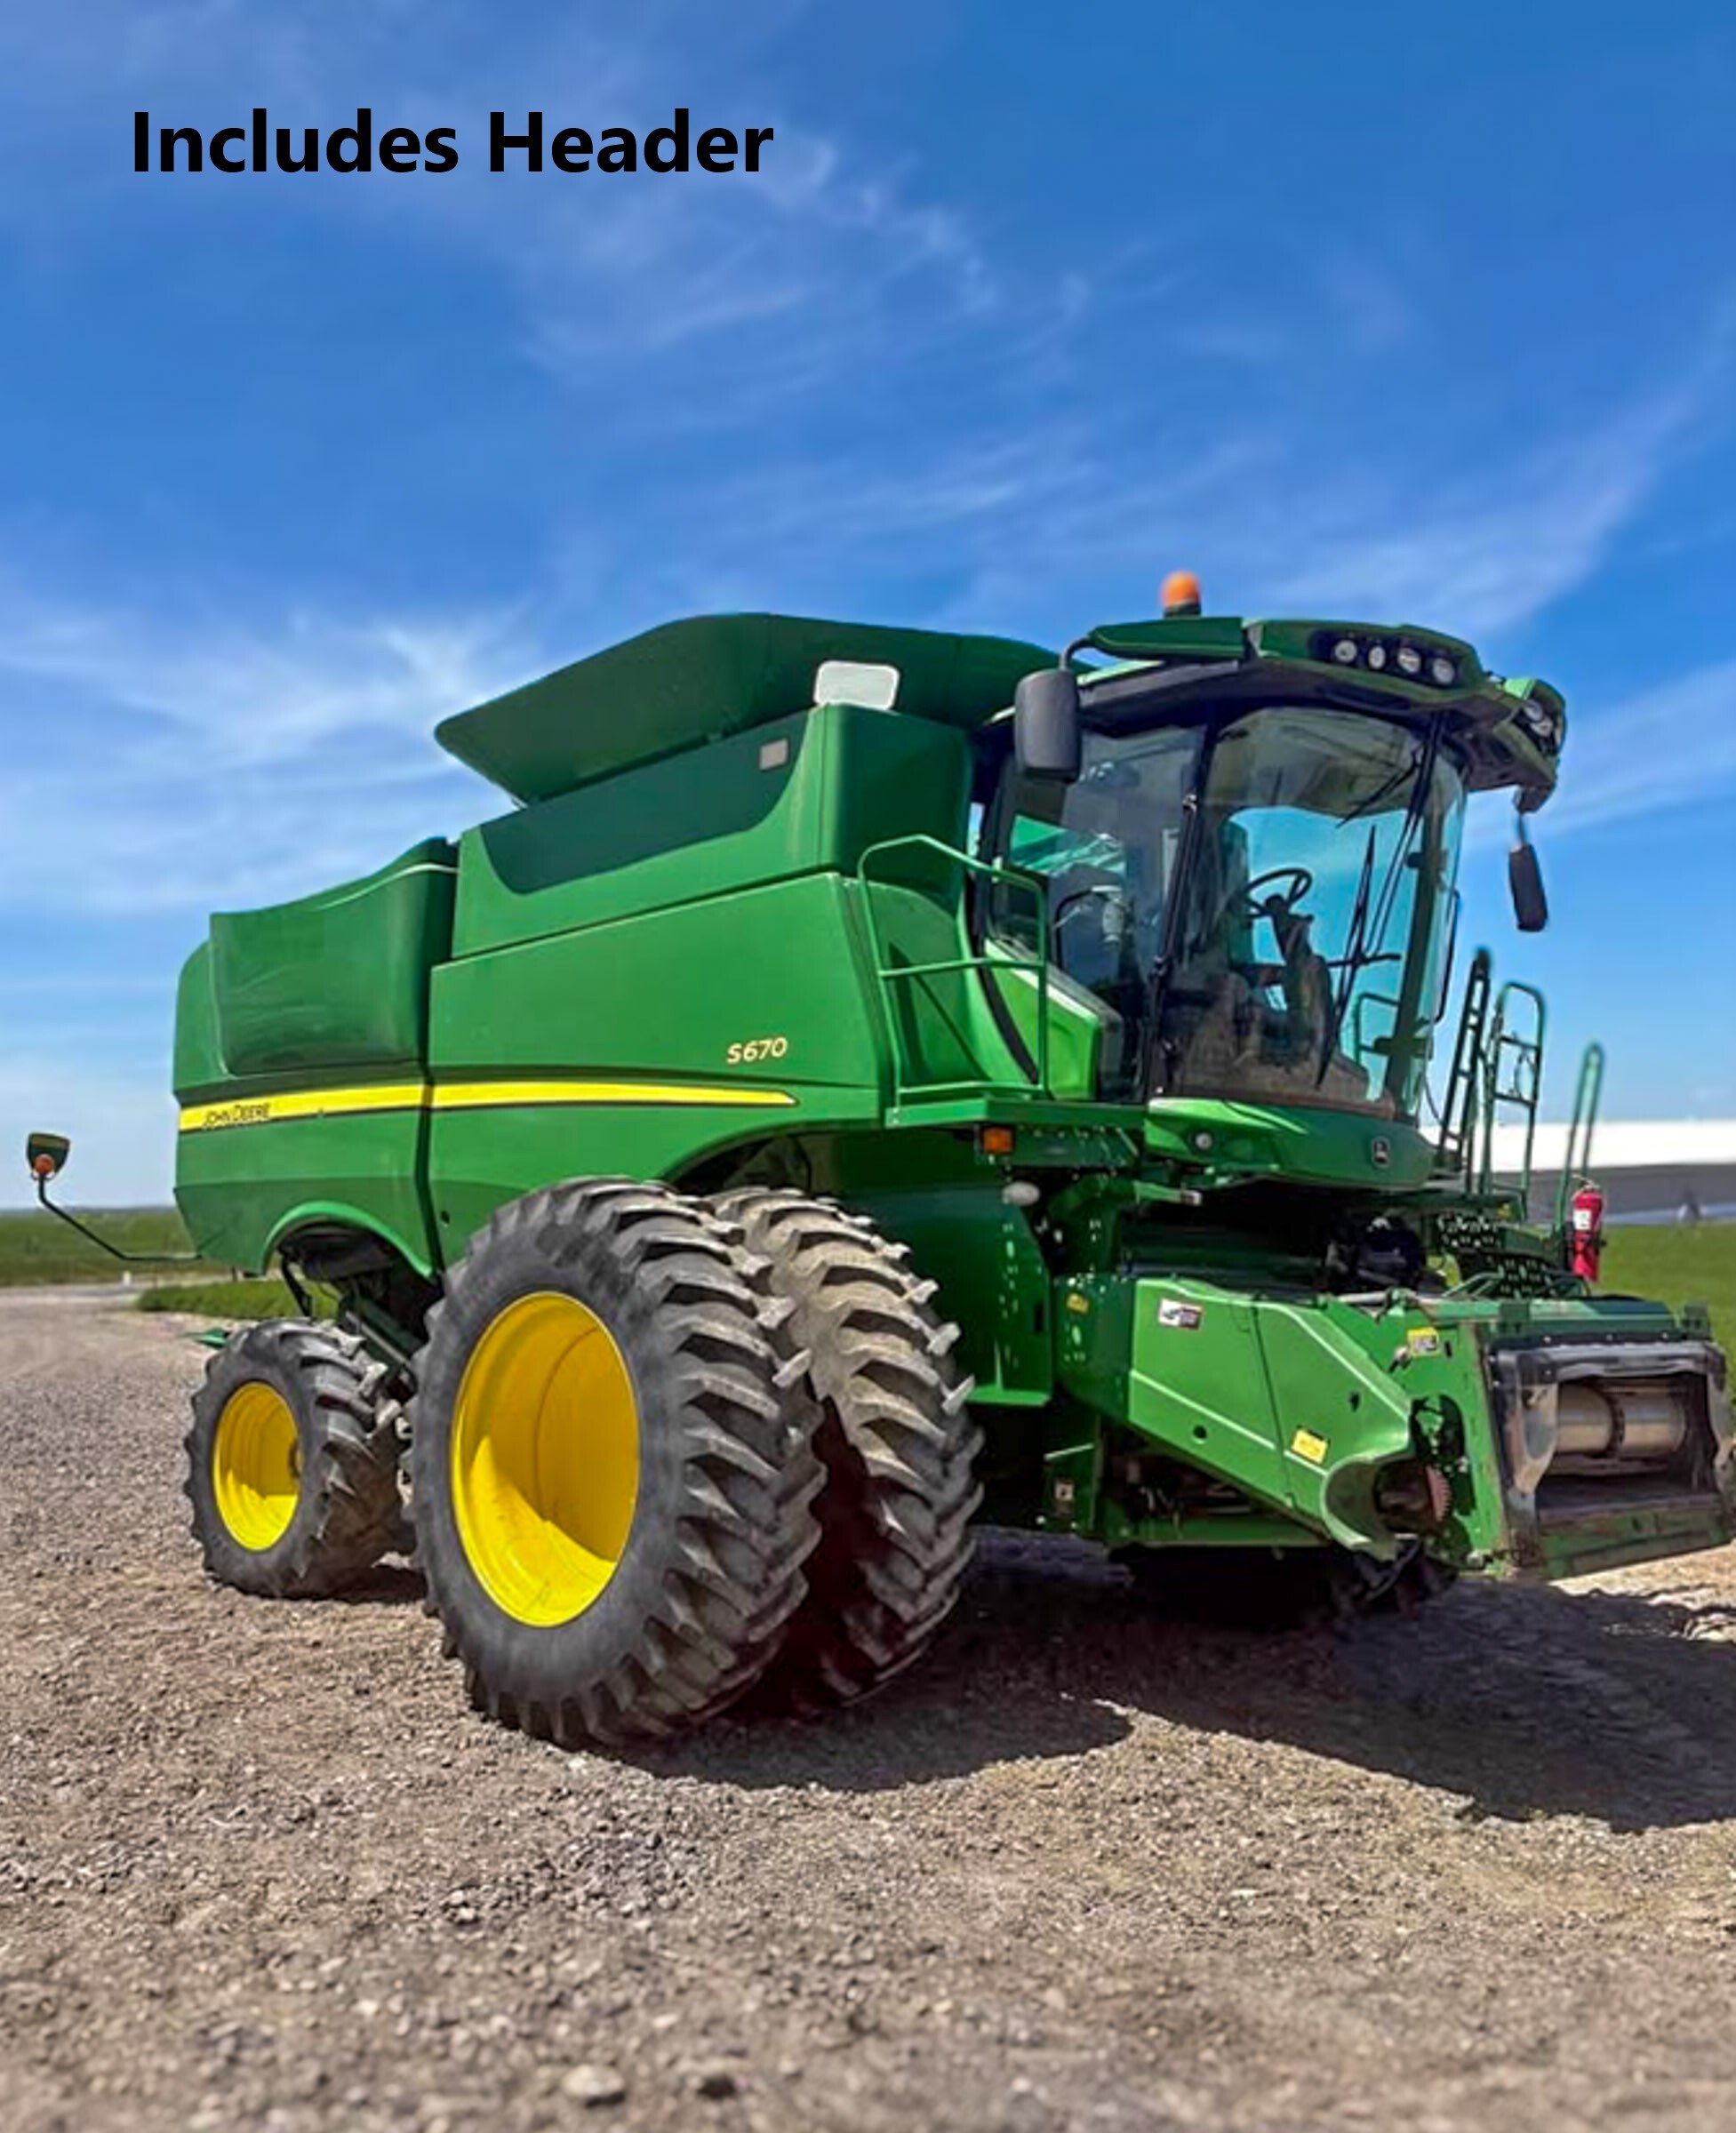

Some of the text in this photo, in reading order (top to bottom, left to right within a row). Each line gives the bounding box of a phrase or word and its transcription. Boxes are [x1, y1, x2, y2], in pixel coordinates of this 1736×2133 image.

[727, 1036, 788, 1065] S670
[202, 1102, 271, 1127] JOHN DEERE
